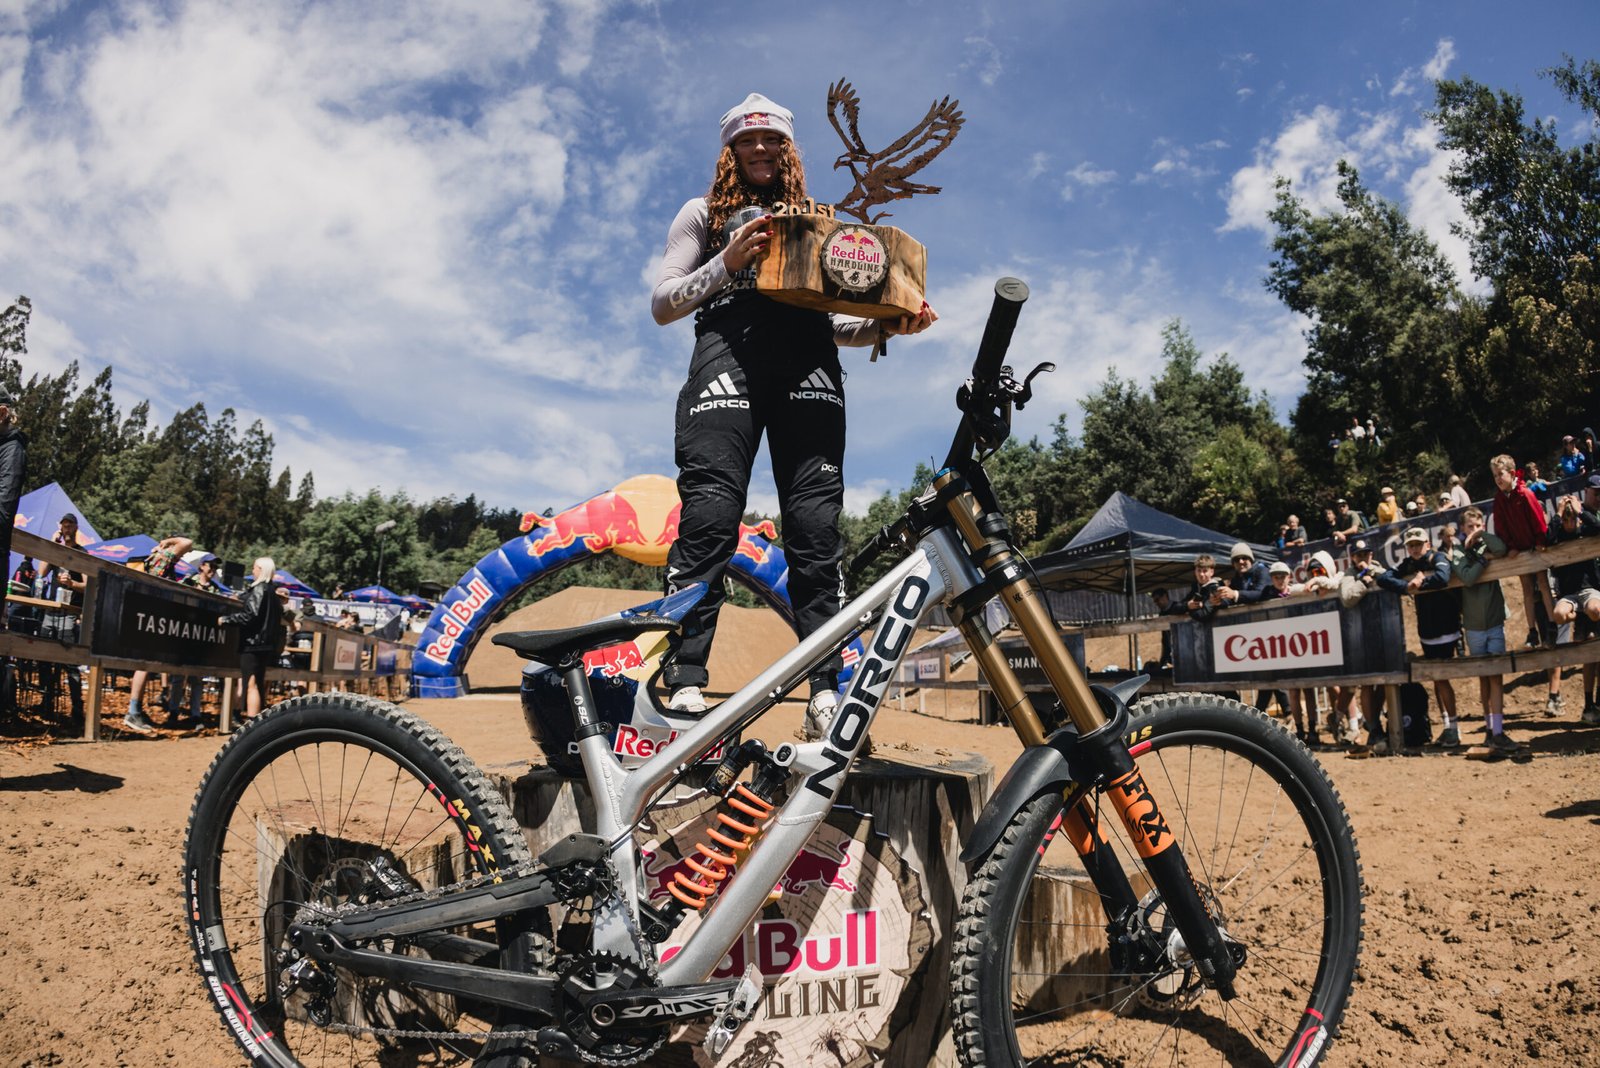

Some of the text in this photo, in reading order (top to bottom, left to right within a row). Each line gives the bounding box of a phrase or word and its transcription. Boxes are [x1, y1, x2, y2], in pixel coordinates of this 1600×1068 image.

[830, 257, 880, 273] HARDLINE
[831, 245, 880, 264] Red Bull
[689, 399, 750, 416] NORCO
[789, 391, 843, 407] NORCO
[136, 612, 226, 645] TASMANIAN
[426, 579, 490, 663] Red Bull
[1223, 629, 1330, 662] Canon
[1008, 656, 1040, 669] SMAN
[804, 575, 931, 801] NORCO
[1121, 772, 1171, 848] FOX
[757, 910, 877, 976] Bull
[765, 973, 881, 1021] LINE
